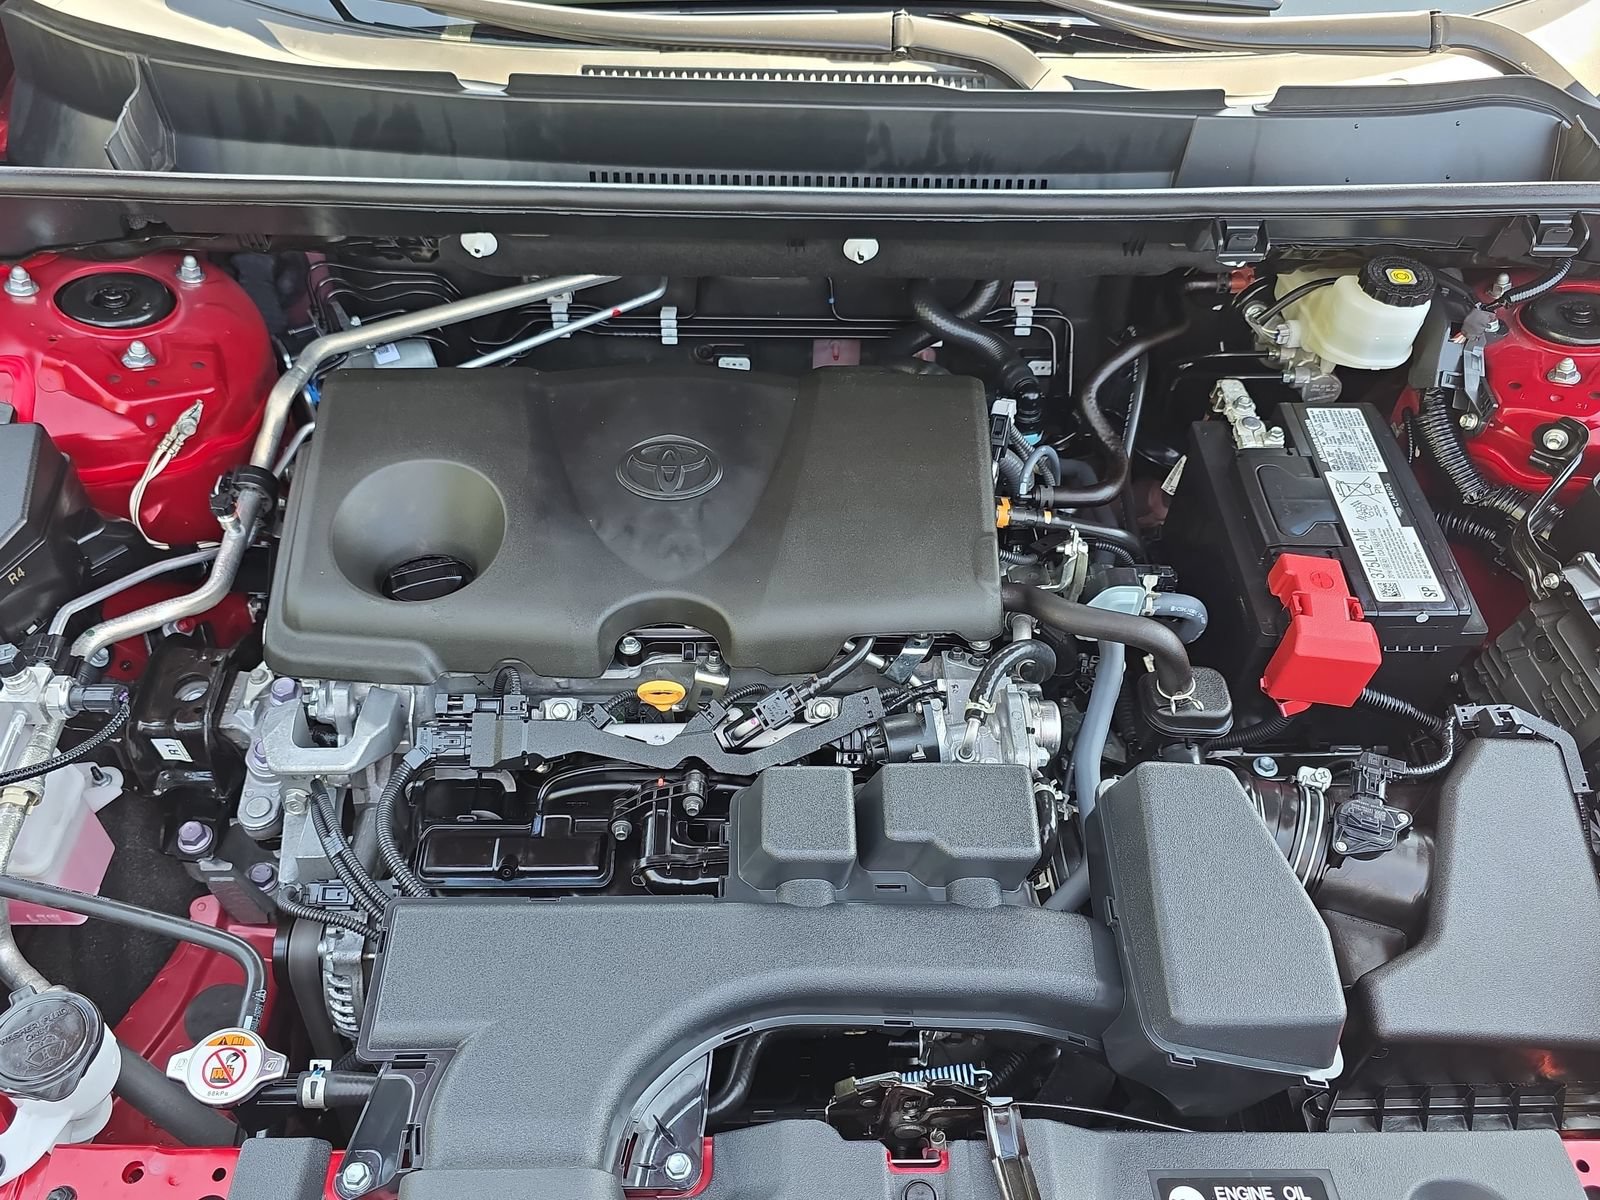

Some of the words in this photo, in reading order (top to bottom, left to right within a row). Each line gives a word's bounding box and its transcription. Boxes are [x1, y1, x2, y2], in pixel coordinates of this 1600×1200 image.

[1384, 482, 1399, 507] CLARIOS
[1351, 527, 1385, 579] 375LN2-MF
[8, 566, 25, 585] R4
[1421, 586, 1438, 598] SP
[164, 743, 181, 756] R1
[1214, 1186, 1275, 1200] ENGINE
[1283, 1186, 1313, 1200] OIL
